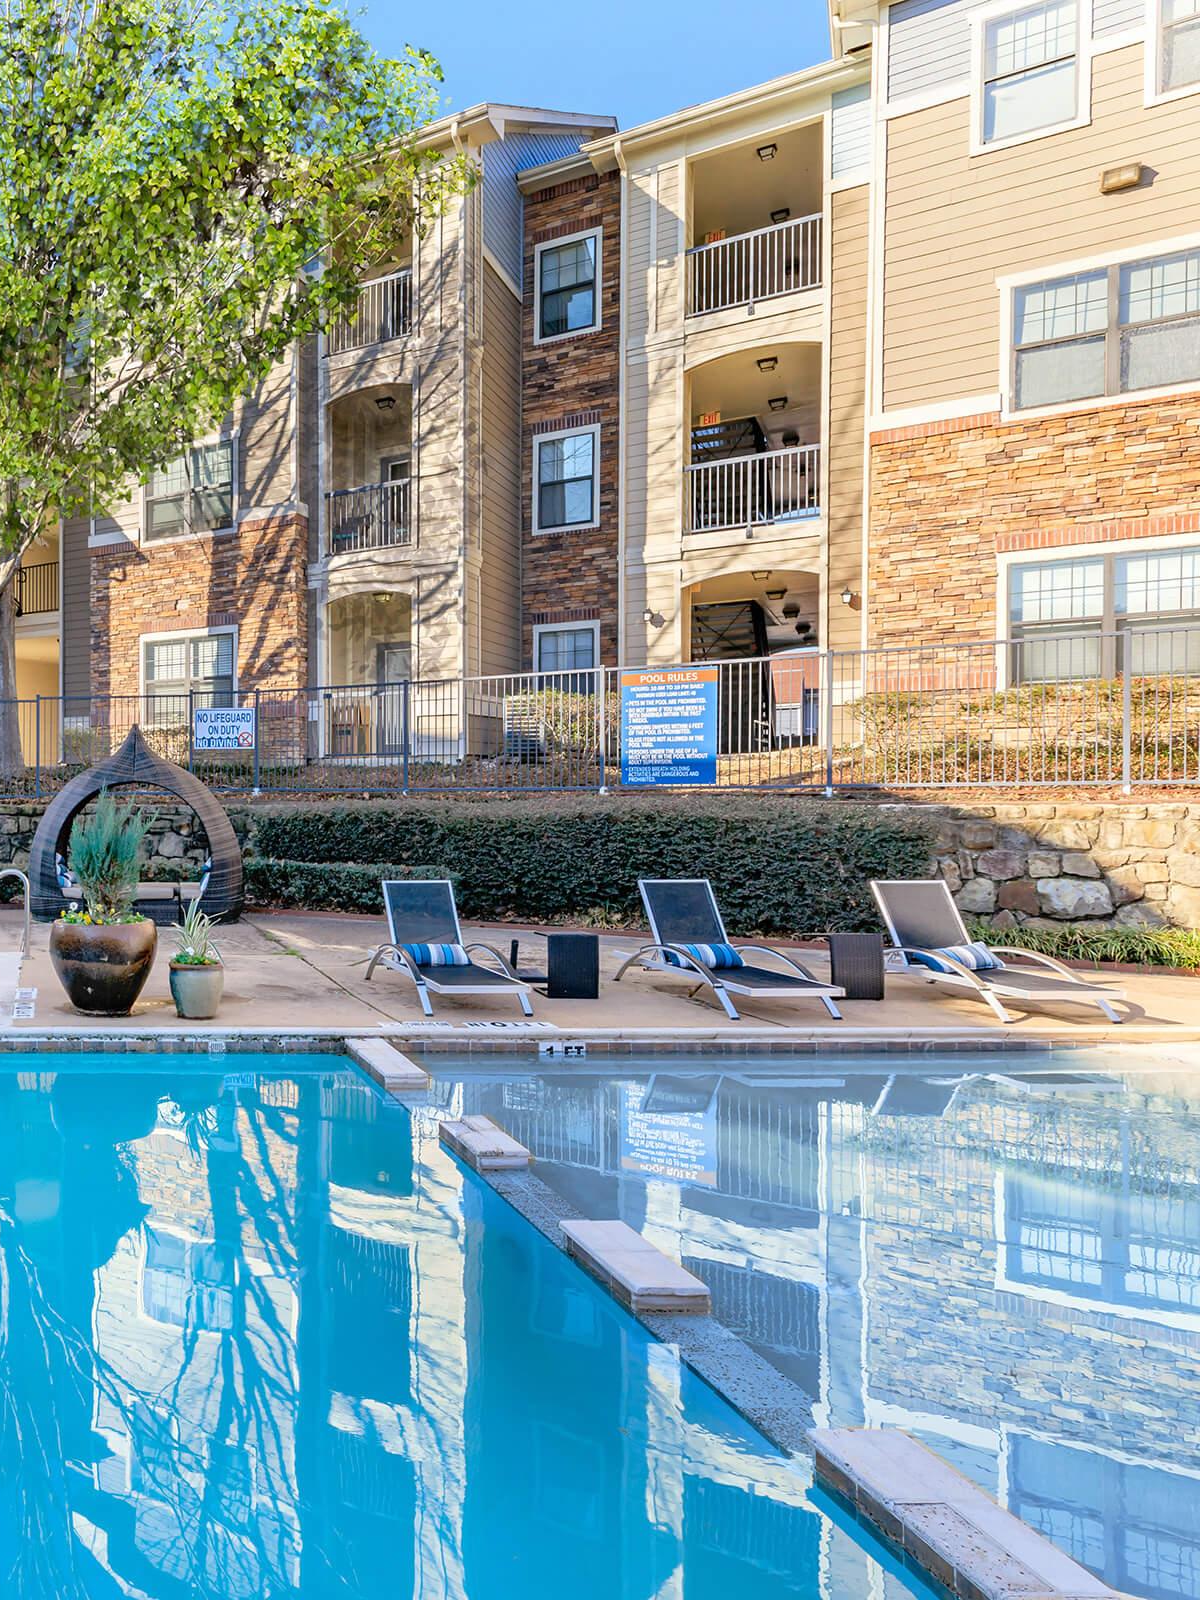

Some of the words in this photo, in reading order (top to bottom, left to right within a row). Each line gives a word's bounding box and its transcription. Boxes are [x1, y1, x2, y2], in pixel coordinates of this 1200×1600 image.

[640, 674, 665, 683] POOL
[668, 672, 698, 681] RULES
[197, 713, 208, 723] NO
[210, 713, 251, 723] LIFEGUARD
[208, 726, 218, 735] ON
[221, 725, 240, 735] DUTY
[197, 738, 208, 748] NO
[211, 738, 238, 748] DIVING
[546, 1046, 553, 1055] 1
[564, 1046, 584, 1055] FT
